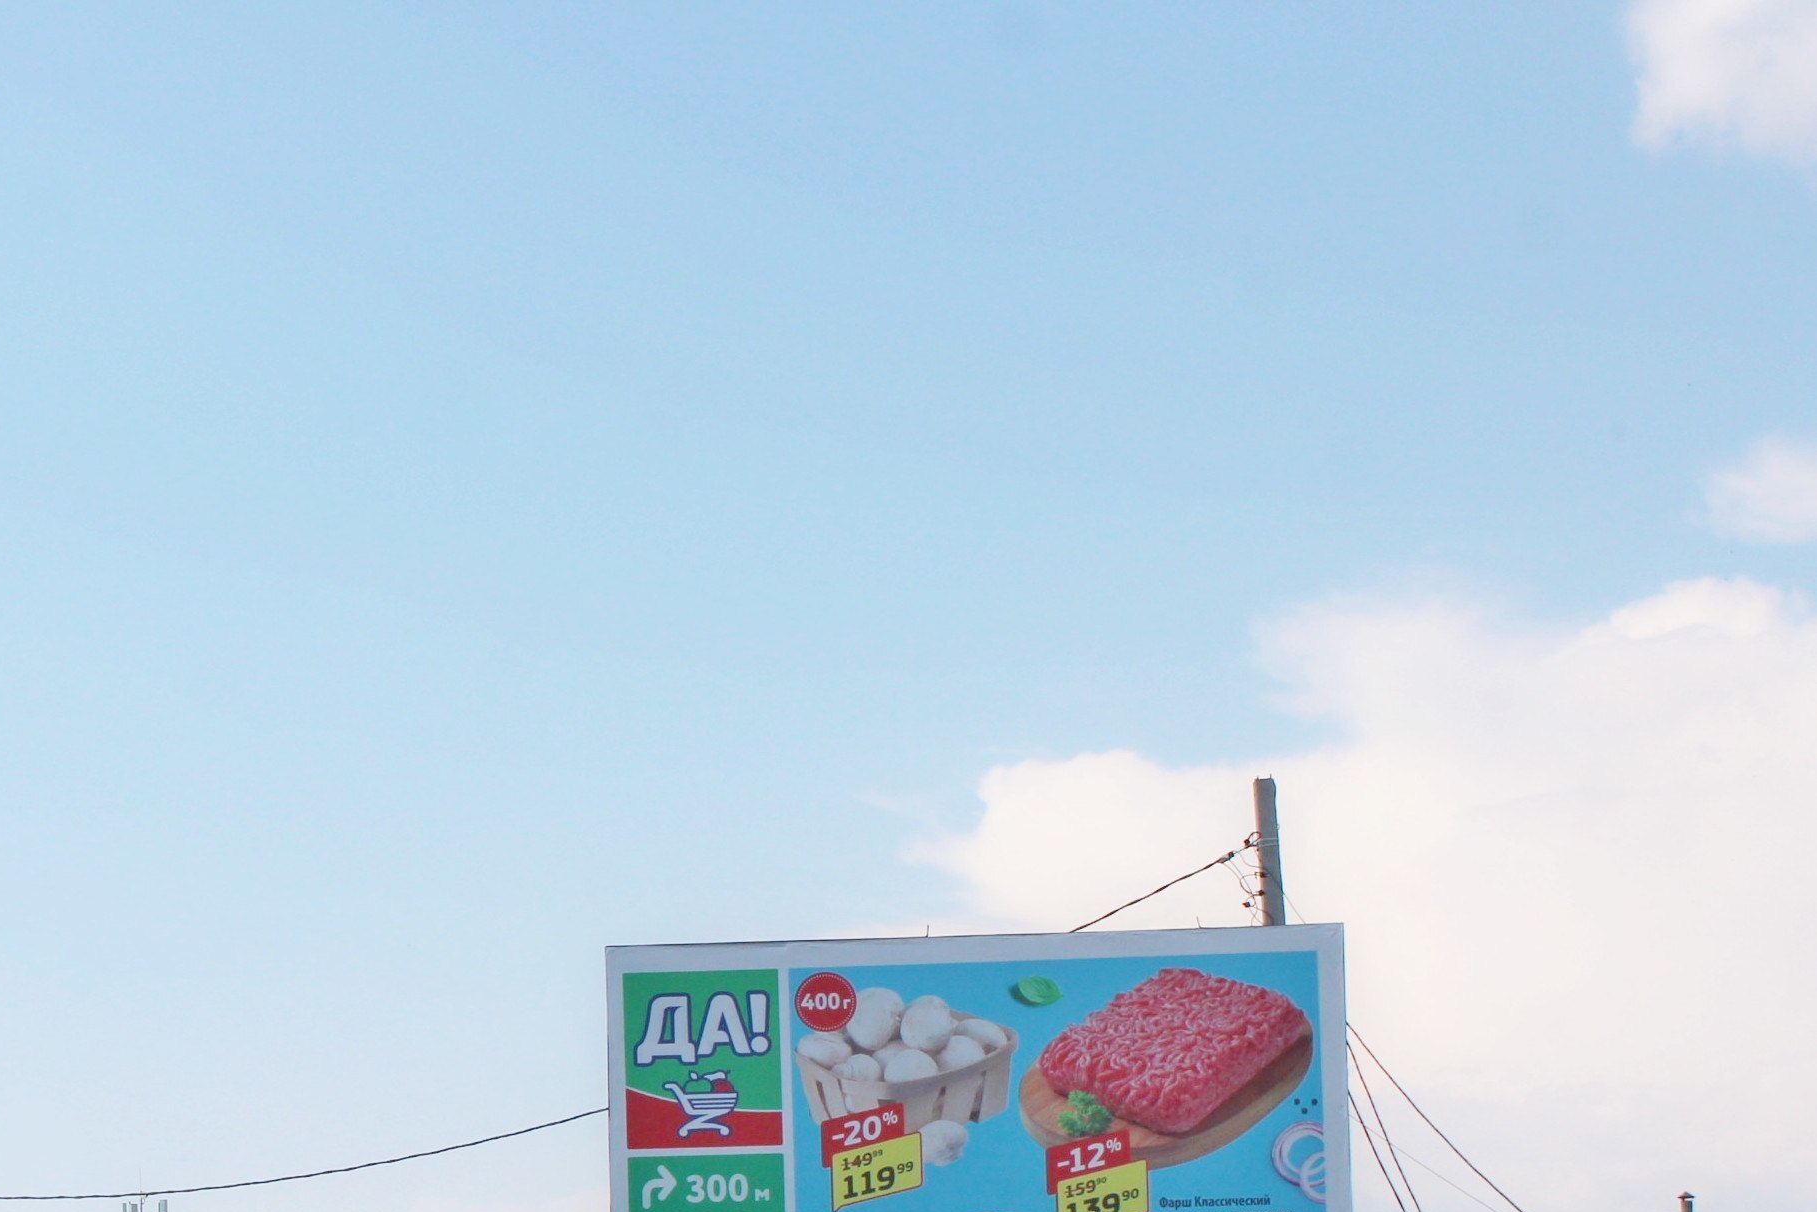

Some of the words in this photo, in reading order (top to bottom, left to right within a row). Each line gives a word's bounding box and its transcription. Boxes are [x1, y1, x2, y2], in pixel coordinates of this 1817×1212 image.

[800, 992, 840, 1010] 400
[843, 999, 851, 1009] г
[635, 990, 771, 1066] ДА!
[831, 1110, 899, 1146] -20%
[1056, 1137, 1121, 1174] -12%
[685, 1173, 749, 1203] 300
[754, 1188, 770, 1201] м
[1159, 1196, 1192, 1210] Фарш
[1194, 1194, 1271, 1208] Классический
